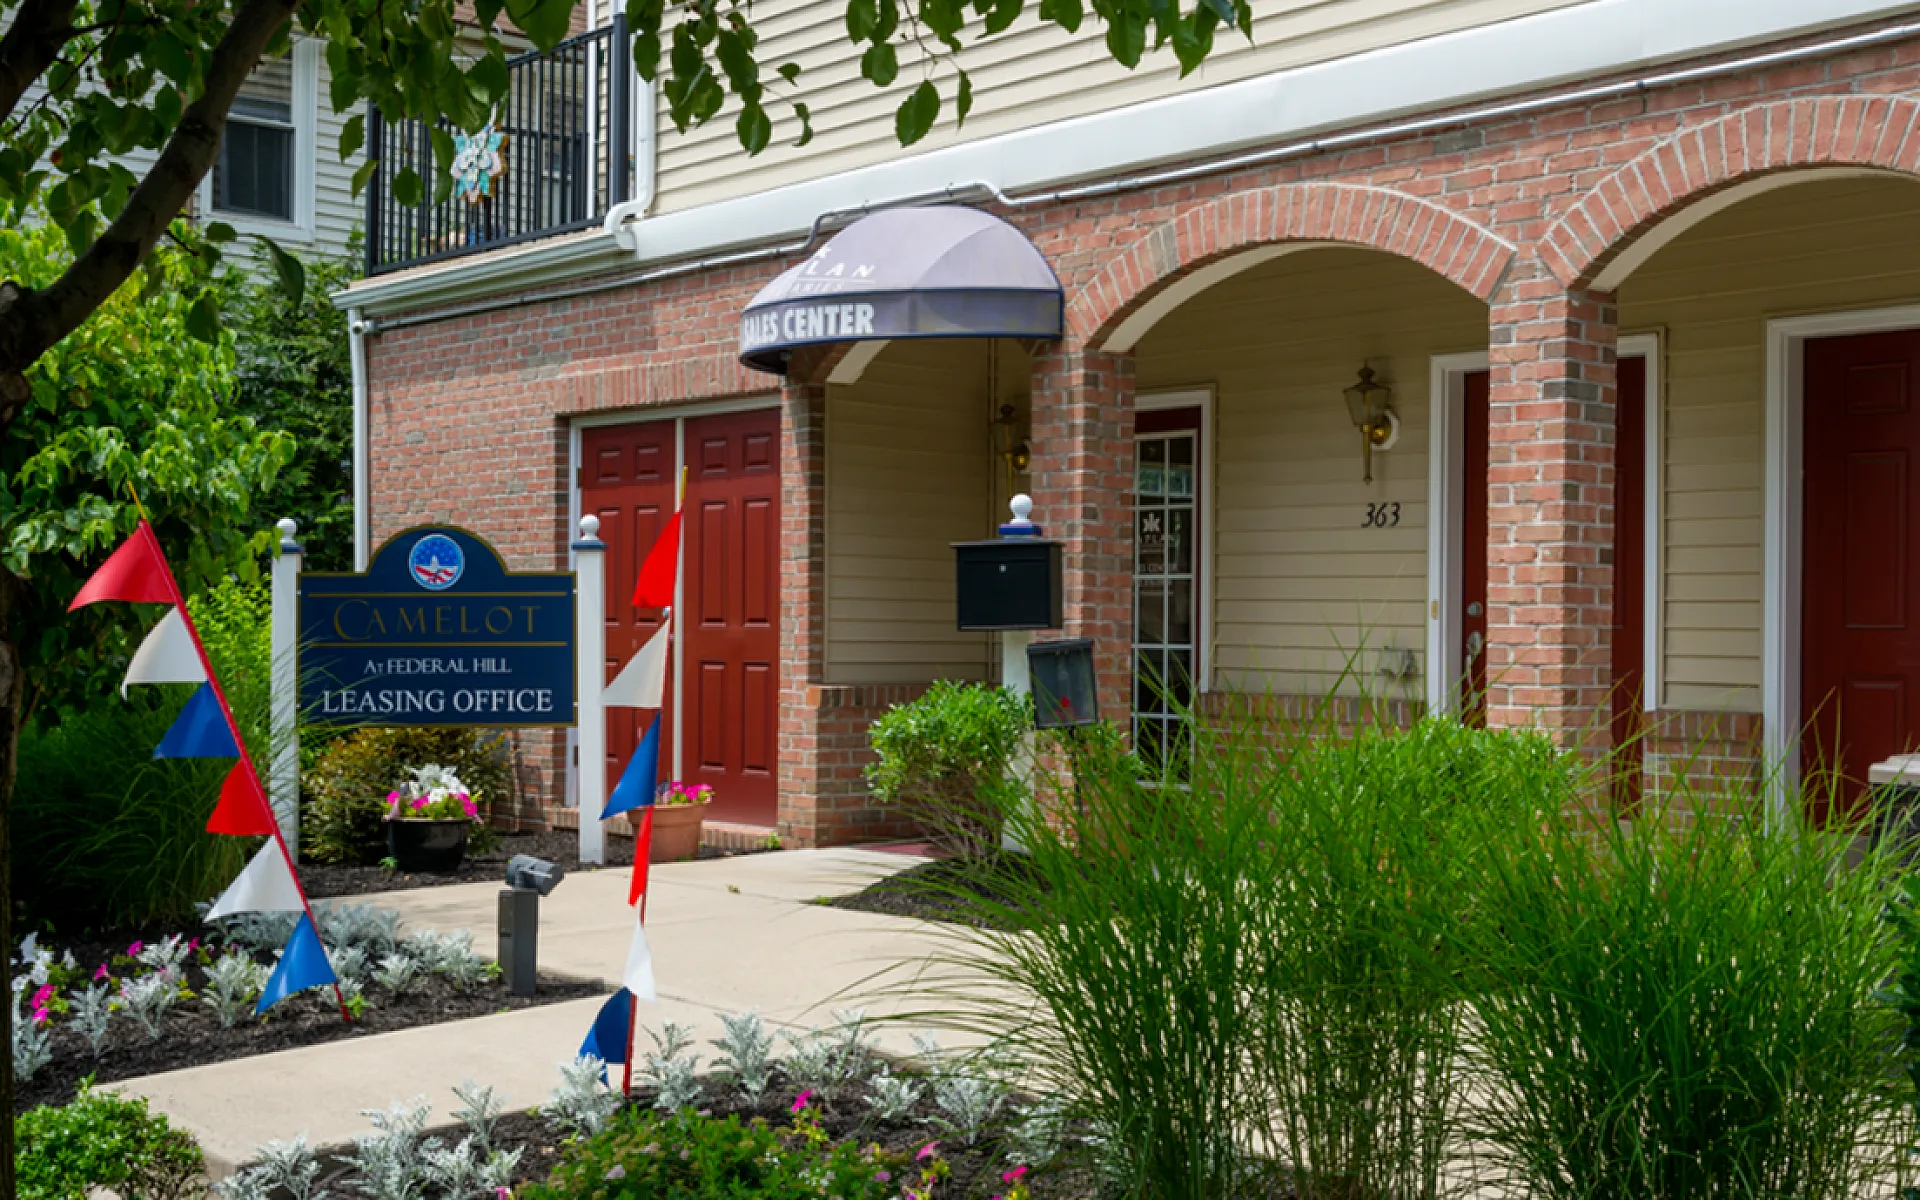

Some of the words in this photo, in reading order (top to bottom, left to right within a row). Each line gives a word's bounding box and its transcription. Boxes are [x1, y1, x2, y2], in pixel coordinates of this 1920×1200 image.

[784, 303, 875, 340] CENTER
[1360, 501, 1401, 528] 363
[333, 599, 542, 642] CAMELOT
[387, 658, 469, 675] FEDERAL
[473, 658, 512, 674] HILL
[322, 690, 446, 713] LEASING
[453, 689, 553, 713] OFFICE
